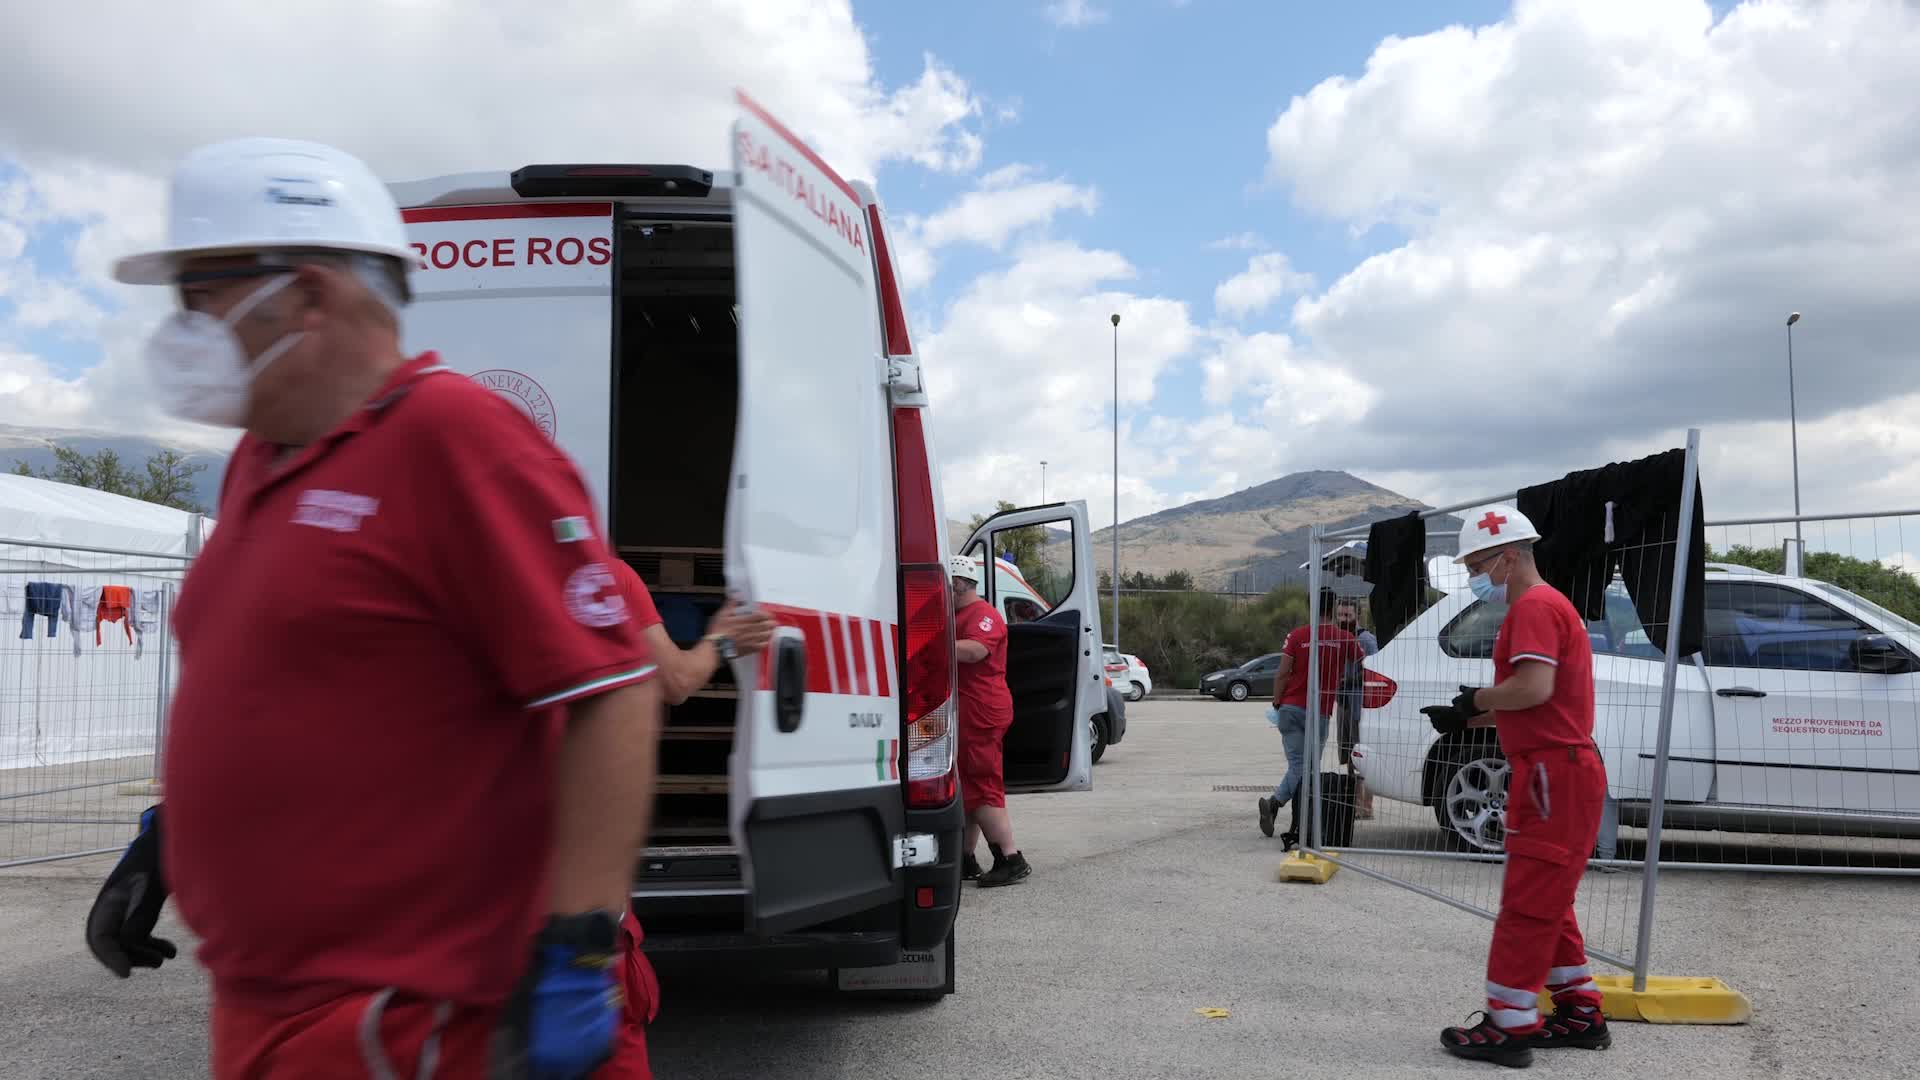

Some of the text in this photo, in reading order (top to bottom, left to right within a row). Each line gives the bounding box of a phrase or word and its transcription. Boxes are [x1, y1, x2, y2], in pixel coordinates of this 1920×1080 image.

[527, 237, 611, 265] ROS
[1772, 717, 1882, 728] MEZZO PROVENIENTE DA
[1772, 725, 1883, 737] SEQUESTRO GIUDIZIARIO
